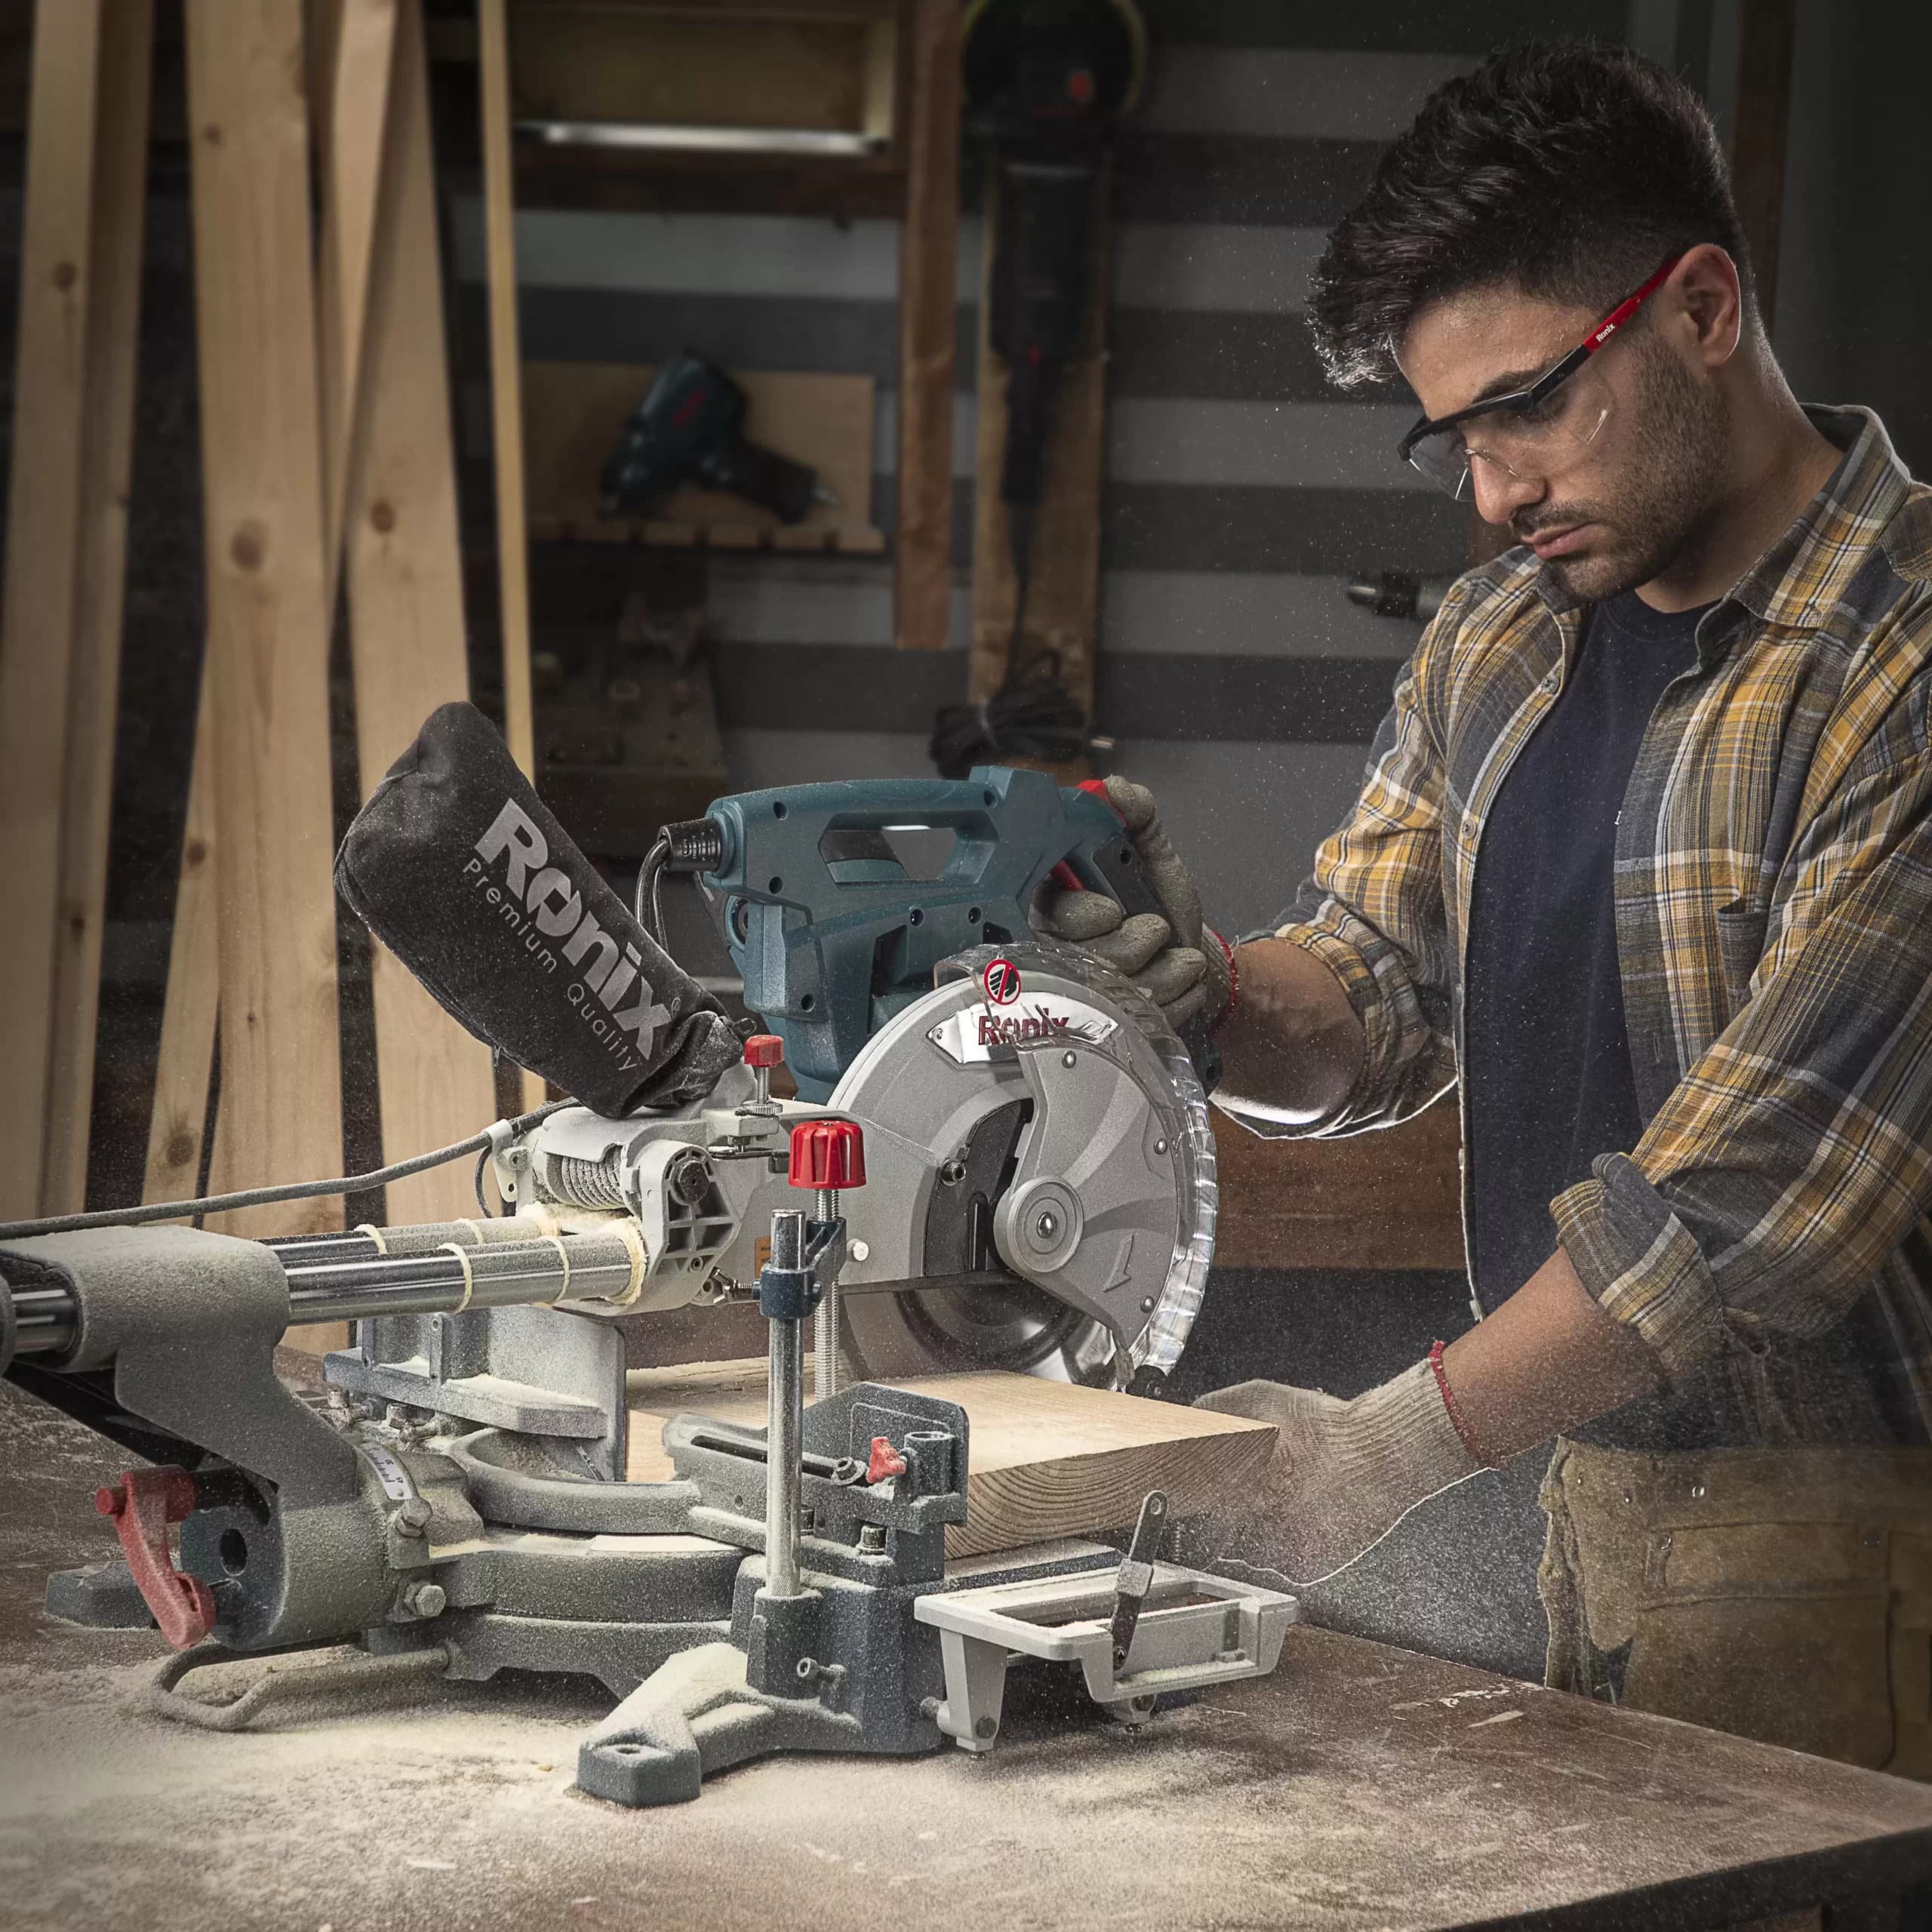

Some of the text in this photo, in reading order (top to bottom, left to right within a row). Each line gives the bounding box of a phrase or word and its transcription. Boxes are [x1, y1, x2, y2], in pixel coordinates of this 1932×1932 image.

[1595, 323, 1616, 342] Ronix
[462, 857, 638, 1072] Premium Quality
[475, 798, 672, 1060] Ronix
